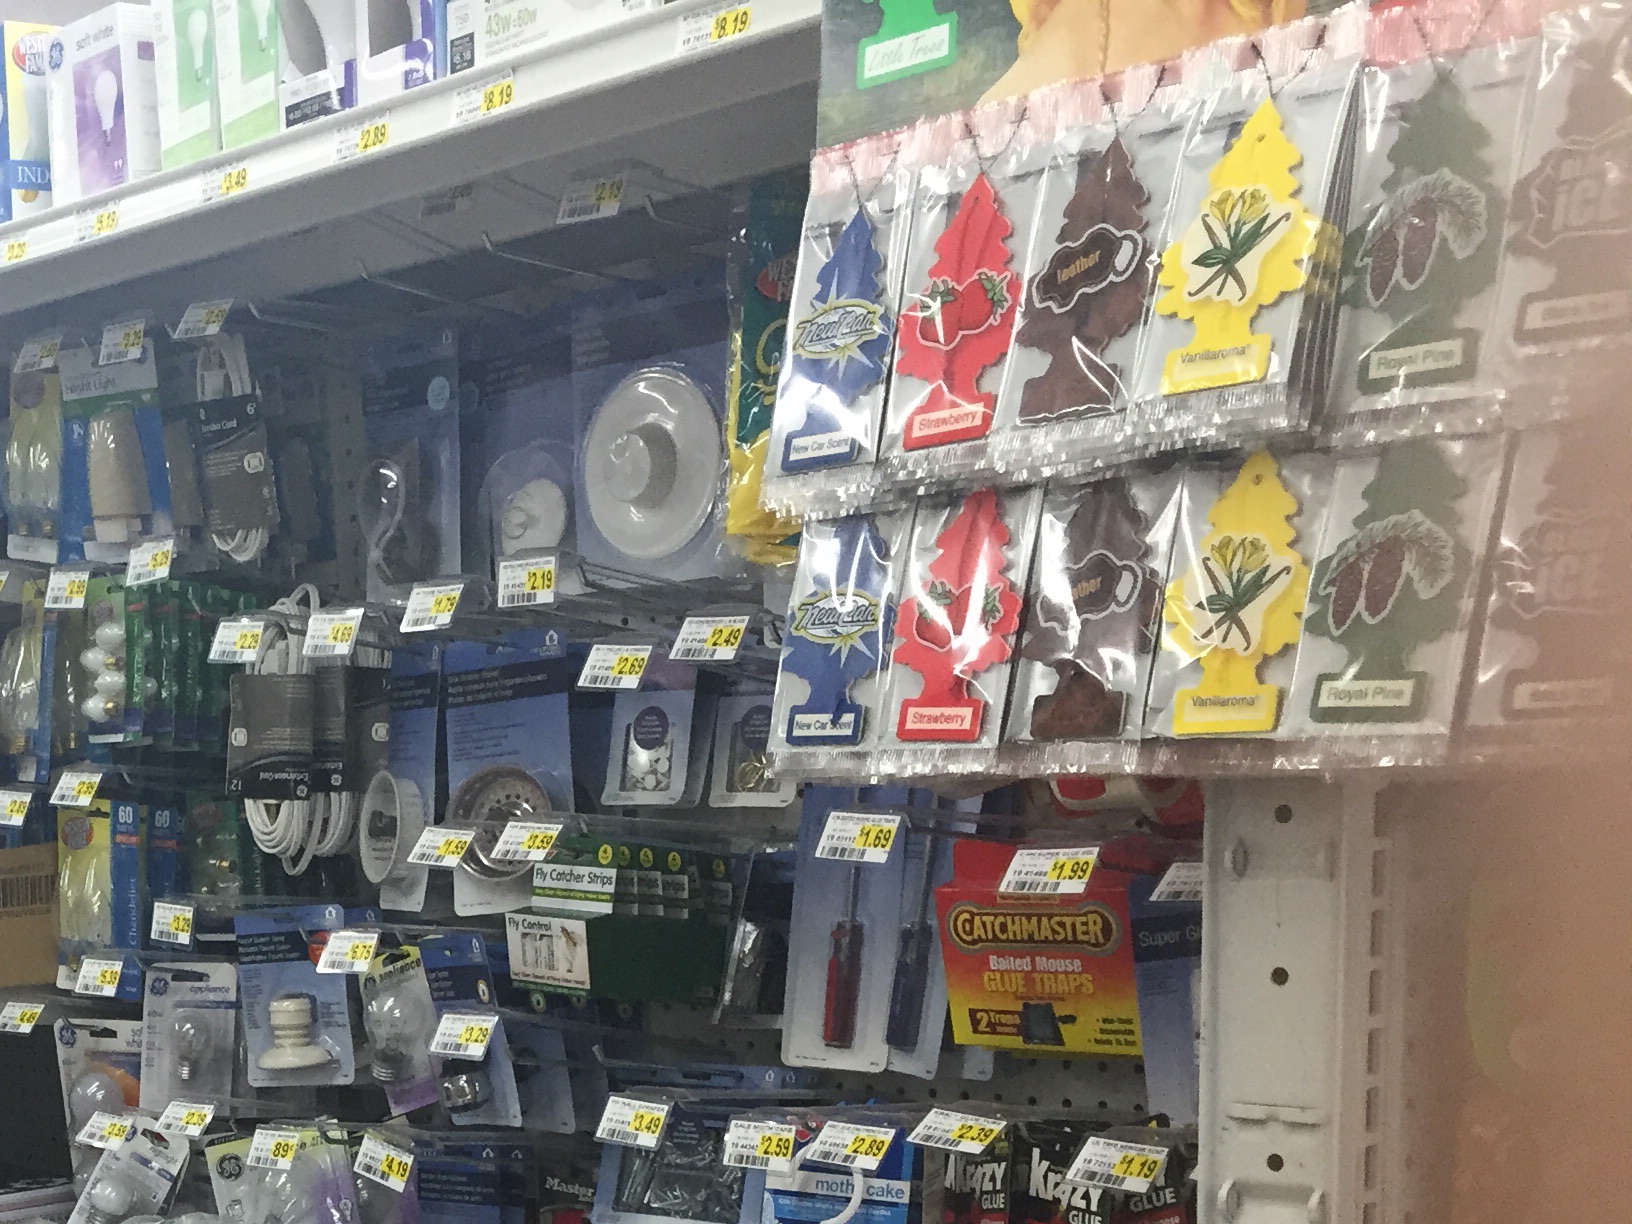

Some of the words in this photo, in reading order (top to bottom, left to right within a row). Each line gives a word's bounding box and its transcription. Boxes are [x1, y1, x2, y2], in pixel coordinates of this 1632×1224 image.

[715, 11, 748, 39] $8.19
[484, 84, 513, 112] $8.19
[918, 410, 978, 431] Strawberry
[527, 570, 553, 591] $2.19
[711, 627, 741, 648] $2.49
[911, 711, 966, 728] Strawberry
[118, 805, 133, 824] 60
[859, 827, 892, 849] $1.69
[535, 867, 549, 883] Fly
[551, 869, 586, 884] Catcher
[587, 871, 614, 888] Strips
[1052, 859, 1090, 882] $1.99
[508, 916, 518, 929] Fly
[521, 917, 552, 931] Control
[956, 906, 1106, 945] CATCHMASTER
[1139, 930, 1182, 948] Super
[989, 954, 1032, 972] Baited
[1036, 955, 1082, 973] Mouse
[984, 972, 1026, 993] GLUE
[1034, 973, 1095, 995] TRAPS
[632, 1112, 660, 1135] $3.49
[958, 1123, 995, 1144] $2.39
[761, 1135, 790, 1157] $2.59
[851, 1134, 885, 1156] $2.89
[1119, 1154, 1157, 1179] $1.19
[545, 1177, 594, 1197] Master
[815, 1177, 855, 1195] moth
[867, 1182, 906, 1200] cake
[981, 1193, 1006, 1210] GLUE
